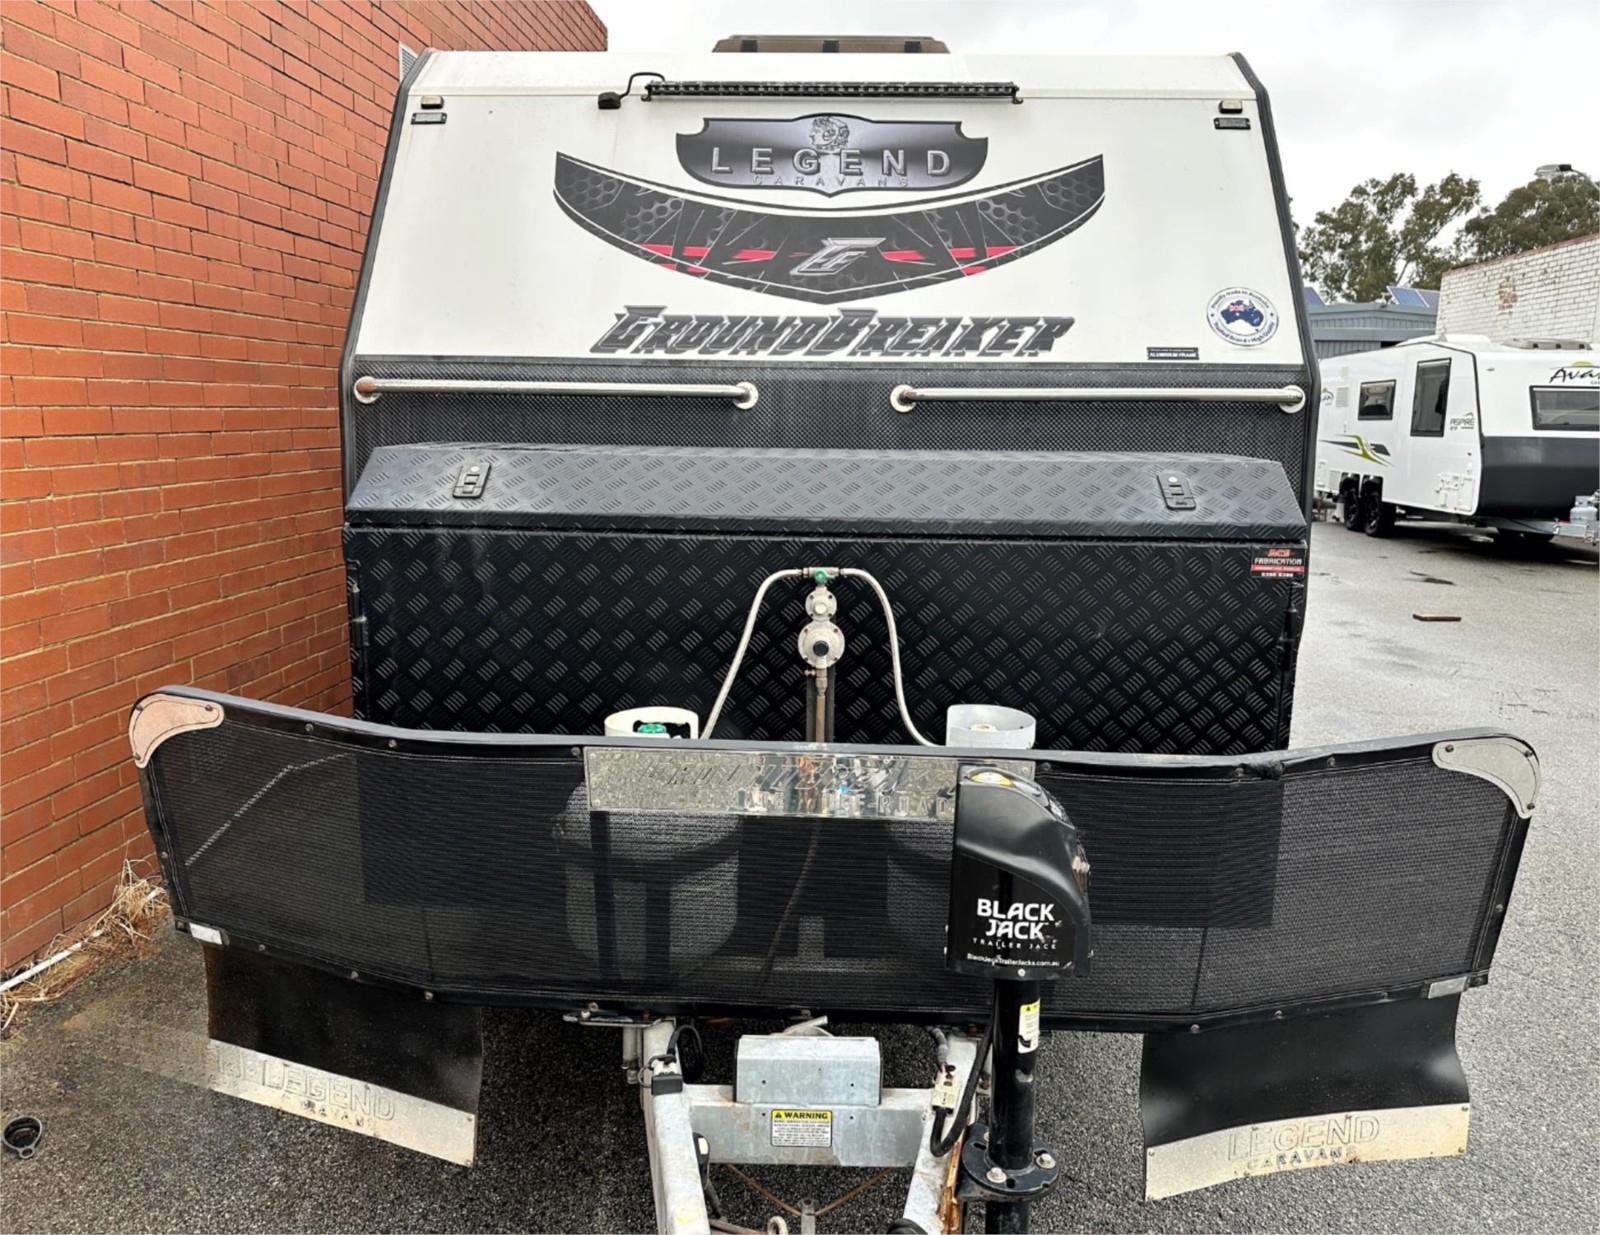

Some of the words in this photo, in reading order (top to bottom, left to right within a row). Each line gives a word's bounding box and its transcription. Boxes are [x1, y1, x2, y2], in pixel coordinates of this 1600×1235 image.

[710, 147, 952, 177] LEGEND
[751, 174, 909, 188] CARAVANS
[590, 305, 1075, 357] GROUNDBREAKER
[1254, 557, 1302, 565] FABRICATION
[977, 898, 1055, 921] BLACK
[985, 918, 1044, 939] JACK
[973, 938, 1021, 949] TRAILER
[262, 1060, 395, 1121] LEGEND
[784, 1111, 828, 1119] WARNING
[1228, 1115, 1380, 1161] LEGEND
